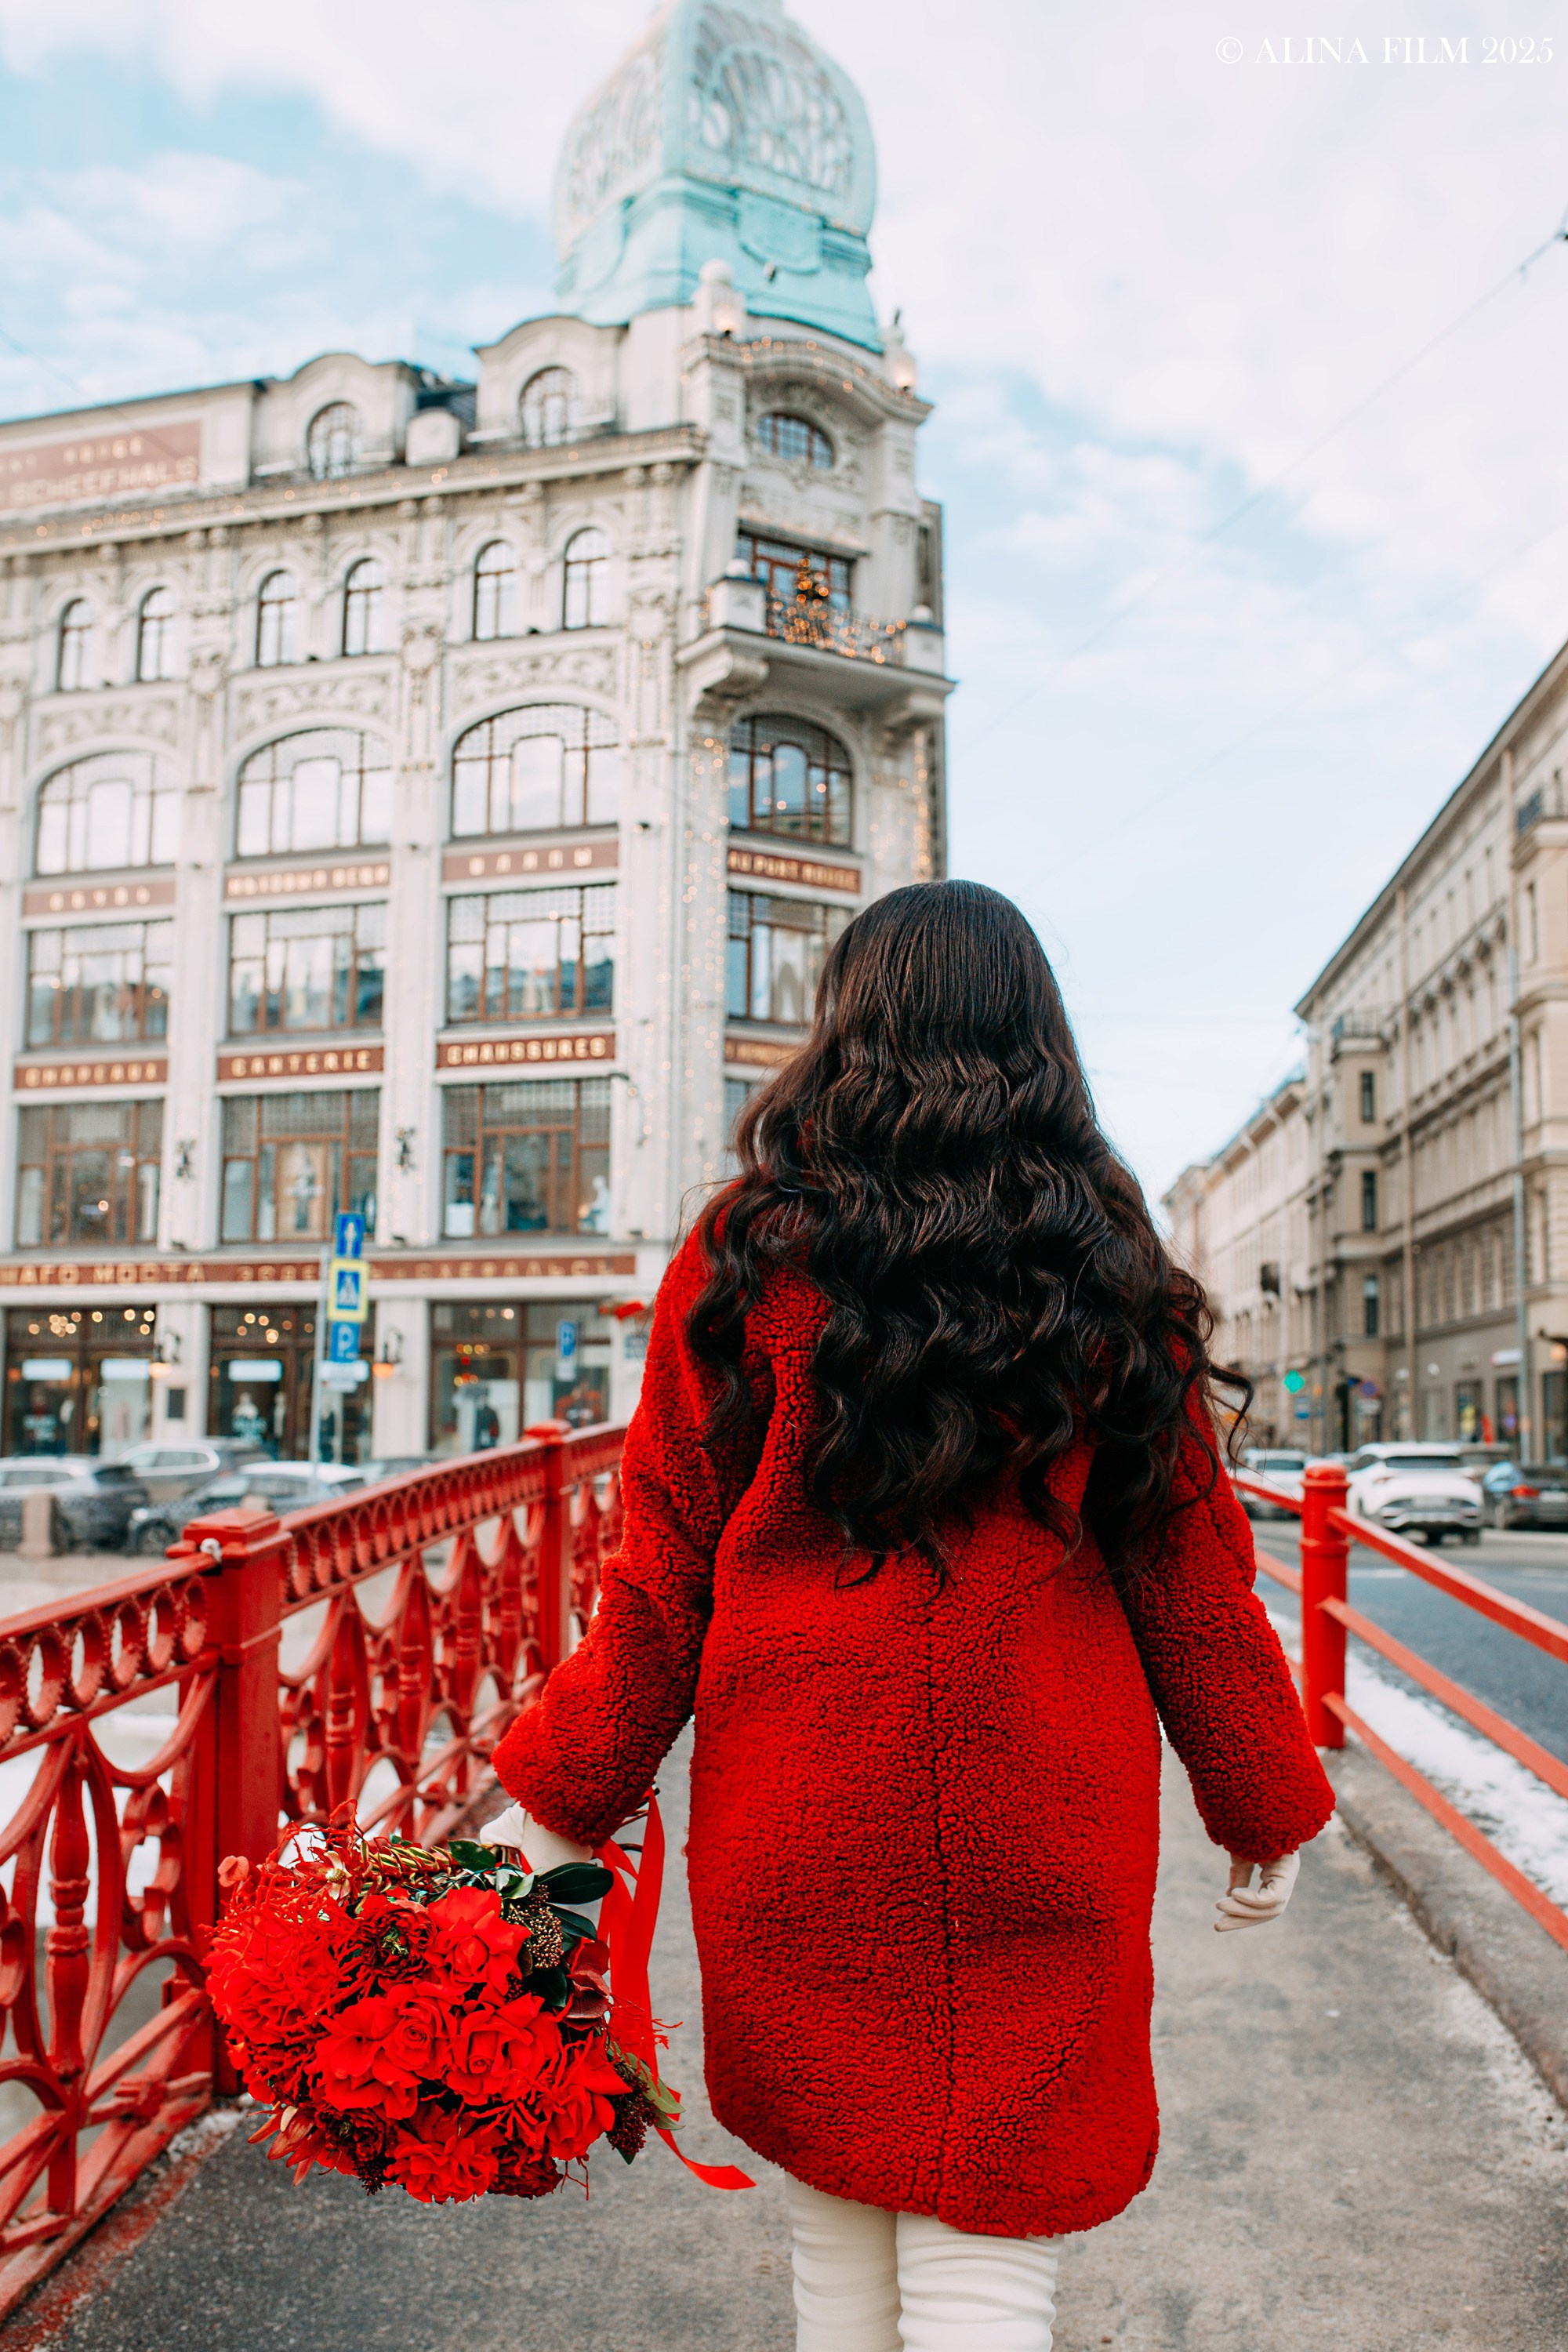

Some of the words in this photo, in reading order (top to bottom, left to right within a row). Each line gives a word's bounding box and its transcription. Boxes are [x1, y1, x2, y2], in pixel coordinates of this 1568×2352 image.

[447, 1036, 606, 1065] CHAUSSURES
[25, 1061, 157, 1087] CHAPEAUX
[93, 1262, 205, 1285] МОСТА
